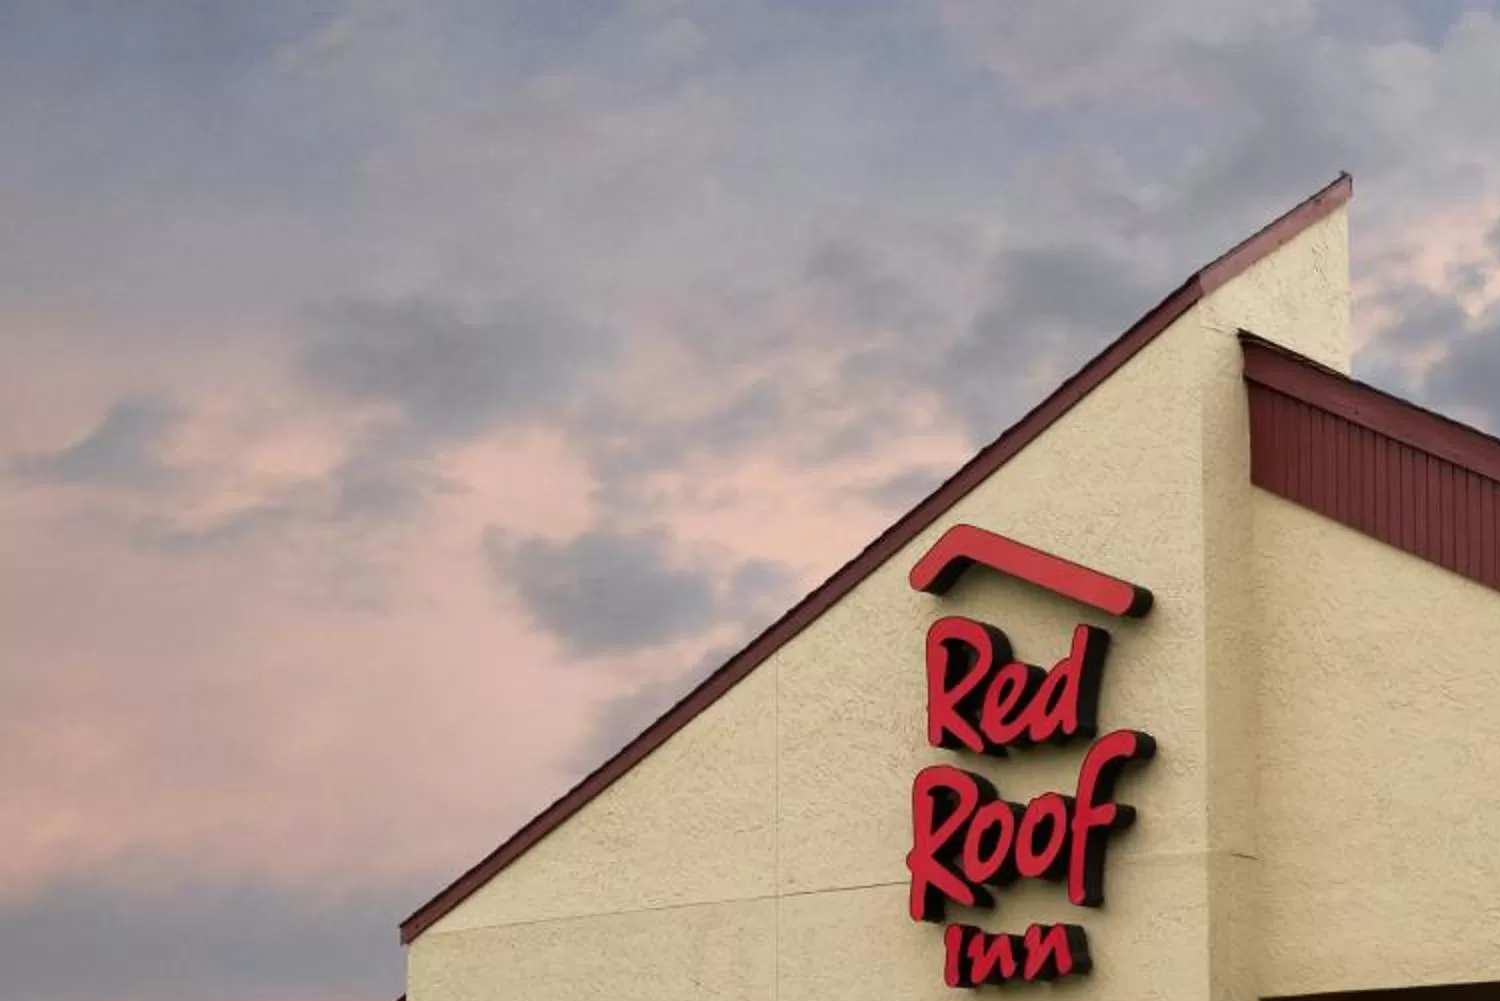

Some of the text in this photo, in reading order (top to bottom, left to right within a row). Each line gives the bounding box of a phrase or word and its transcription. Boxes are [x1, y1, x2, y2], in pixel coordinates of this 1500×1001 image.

[925, 616, 1091, 754] Red
[906, 729, 1141, 922] Roof
[944, 923, 1075, 989] Inn
